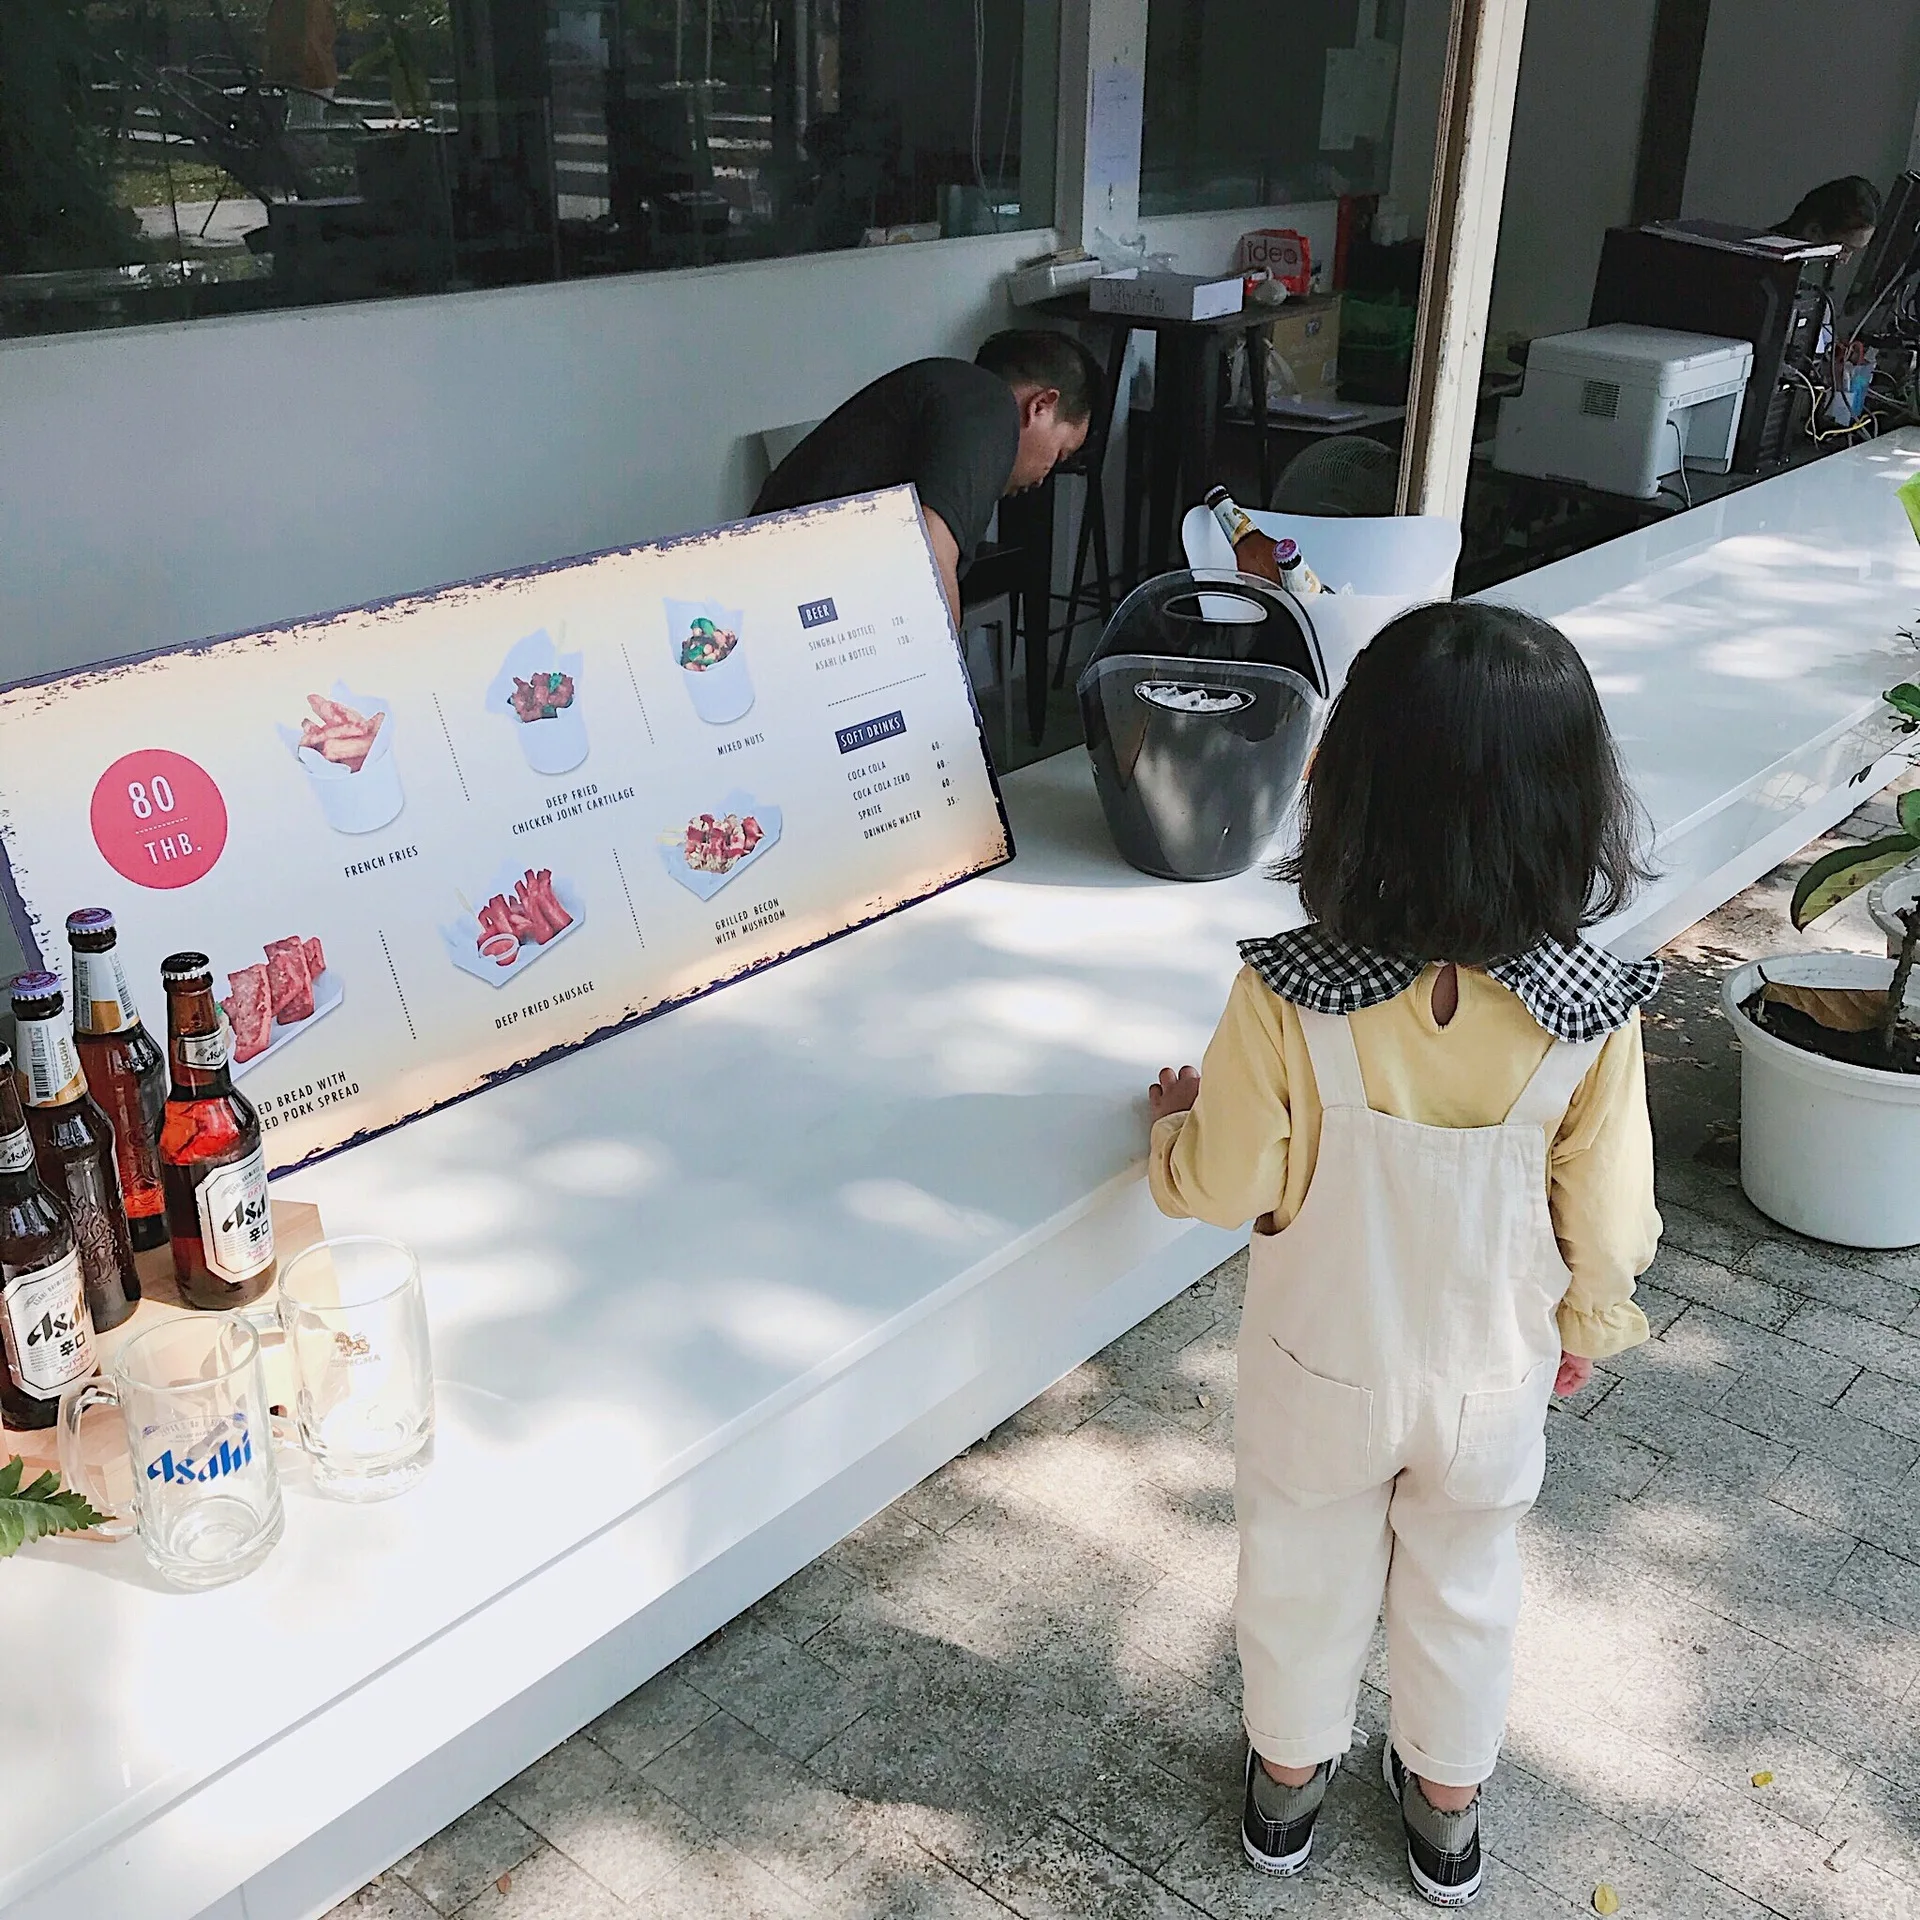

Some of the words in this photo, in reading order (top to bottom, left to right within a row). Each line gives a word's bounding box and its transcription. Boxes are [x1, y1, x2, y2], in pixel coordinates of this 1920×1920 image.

[1248, 239, 1299, 266] idea
[805, 604, 831, 622] BEER
[808, 635, 836, 652] SINGHA
[846, 624, 876, 641] BOTTLE)
[815, 656, 837, 671] ASAHI
[847, 645, 877, 661] BOTTLE)
[717, 740, 743, 756] MIXED
[744, 732, 765, 747] NUTS
[840, 728, 865, 747] SOFT
[866, 716, 901, 739] DRINKS
[847, 768, 867, 782] COCA
[868, 760, 887, 775] COLA
[853, 787, 872, 801] COCA
[873, 780, 892, 794] COLA
[893, 772, 911, 787] ZERO
[127, 775, 176, 820] 80
[511, 813, 553, 836] CHICKEN
[556, 803, 583, 821] JOINT
[586, 786, 636, 811] CARTILAGE
[545, 793, 569, 809] DEEP
[571, 783, 599, 801] FRIED
[858, 803, 883, 821] SPRITE
[863, 818, 898, 840] DRINKING
[898, 809, 922, 826] WATER
[143, 832, 202, 866] THB.
[344, 856, 386, 878] FRENCH
[388, 844, 419, 864] FRIES
[714, 929, 737, 945] WITH
[741, 909, 787, 935] MUSHROOM
[715, 910, 749, 931] GRILLED
[753, 897, 780, 916] BECON
[494, 1011, 519, 1030] DEEP
[521, 999, 550, 1018] FRIED
[552, 981, 595, 1006] SAUSAGE
[257, 1100, 273, 1116] ED
[276, 1084, 314, 1108] BREAD
[316, 1071, 347, 1091] WITH
[283, 1101, 314, 1123] PORK
[317, 1082, 360, 1108] SPREAD
[146, 1428, 252, 1486] Asahi
